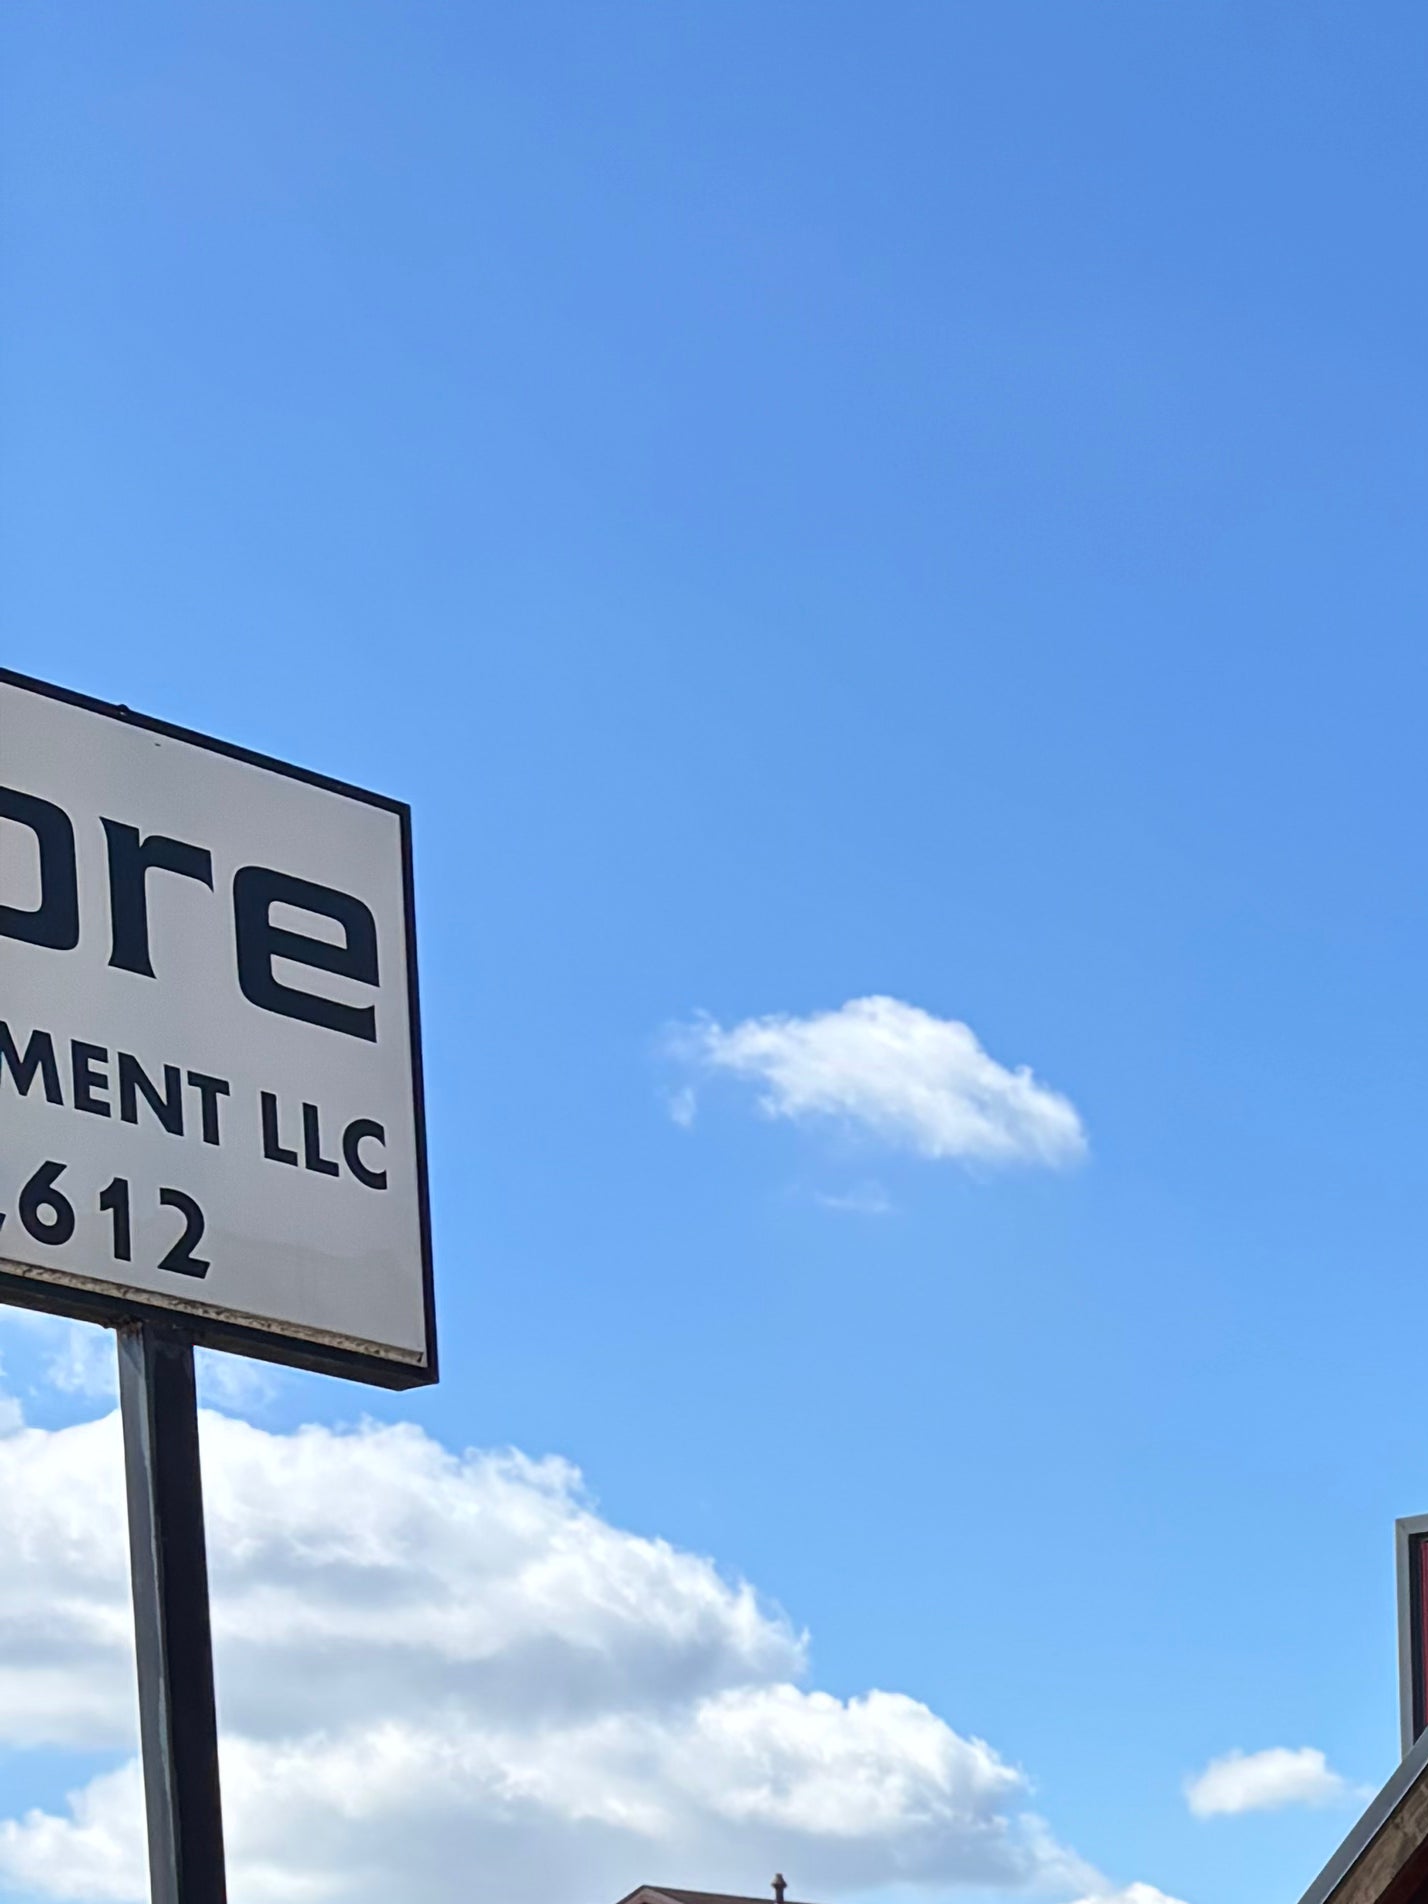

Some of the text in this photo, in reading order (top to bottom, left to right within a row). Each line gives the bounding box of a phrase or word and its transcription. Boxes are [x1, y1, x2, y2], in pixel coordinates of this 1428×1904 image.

[0, 1019, 389, 1190] MENT LLC
[0, 1159, 211, 1280] 612
